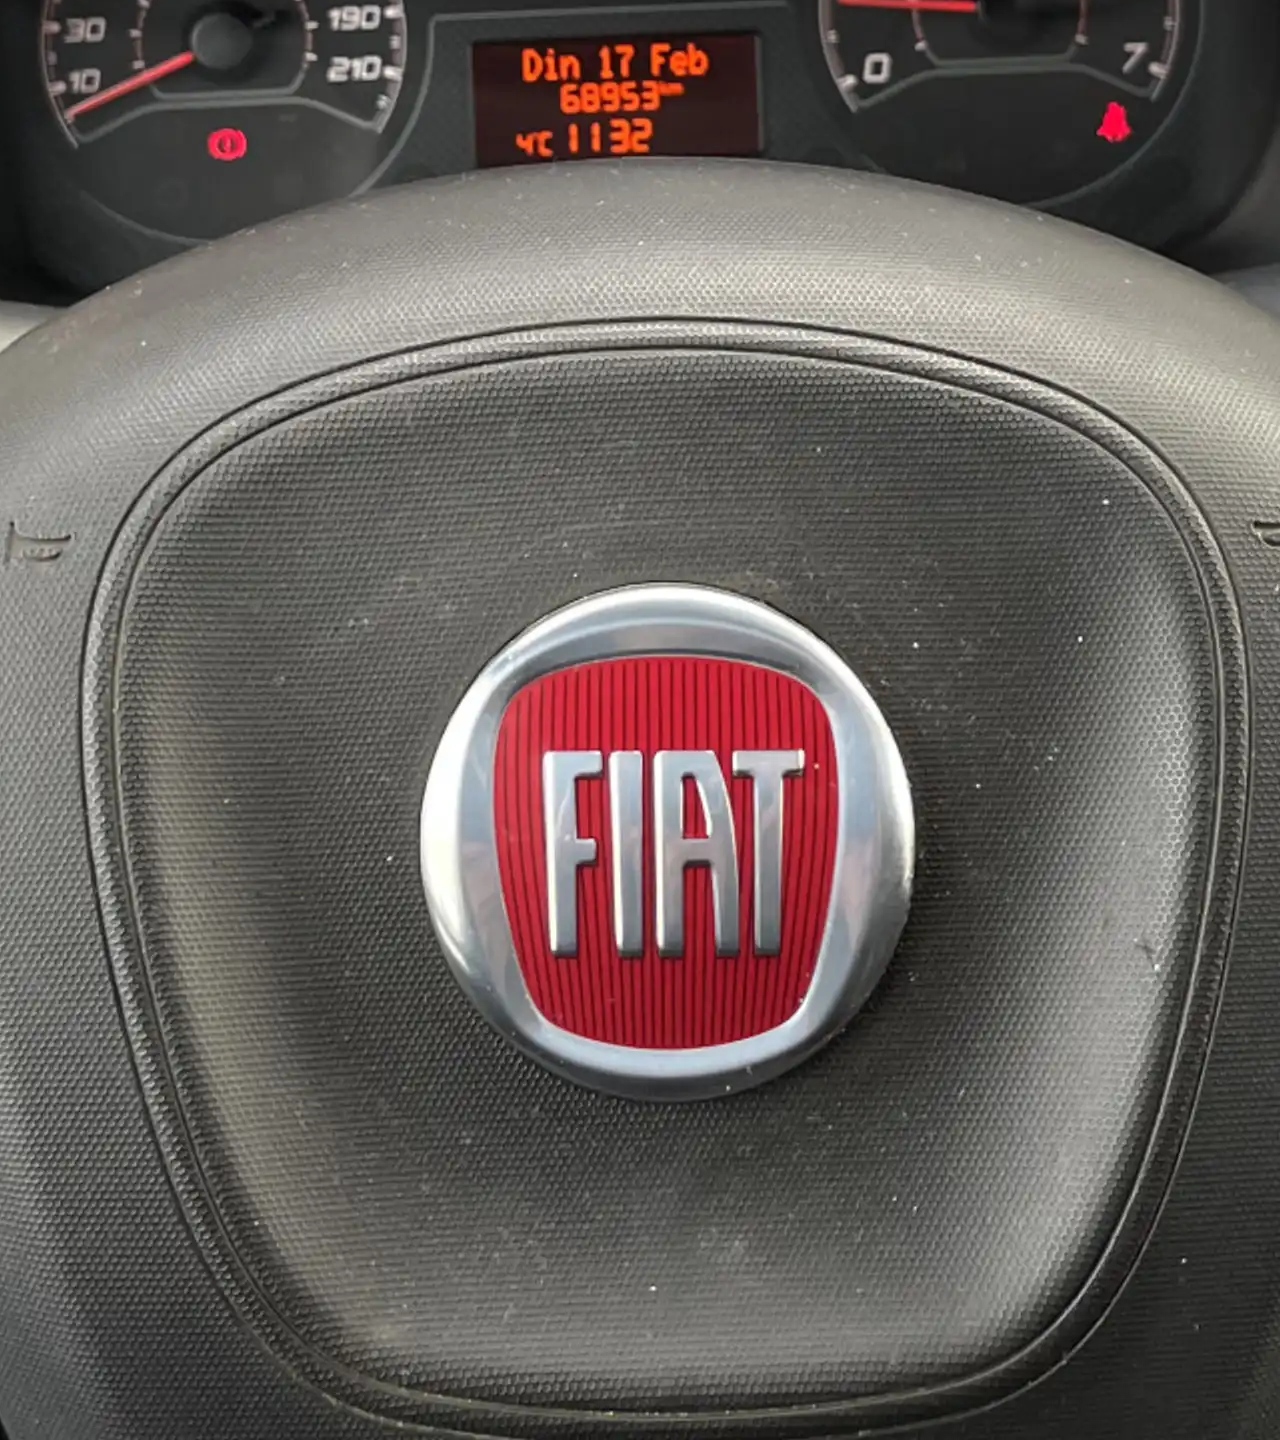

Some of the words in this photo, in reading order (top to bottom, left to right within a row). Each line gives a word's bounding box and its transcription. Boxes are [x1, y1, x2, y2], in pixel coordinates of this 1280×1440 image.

[64, 17, 107, 44] 30
[327, 5, 381, 31] 190
[326, 55, 382, 82] 210
[521, 47, 581, 83] Din
[598, 43, 635, 80] 17
[649, 42, 710, 78] Feb
[862, 52, 892, 84] 0
[1122, 42, 1149, 74] 7
[69, 68, 101, 94] 10
[542, 749, 805, 959] FIAT
